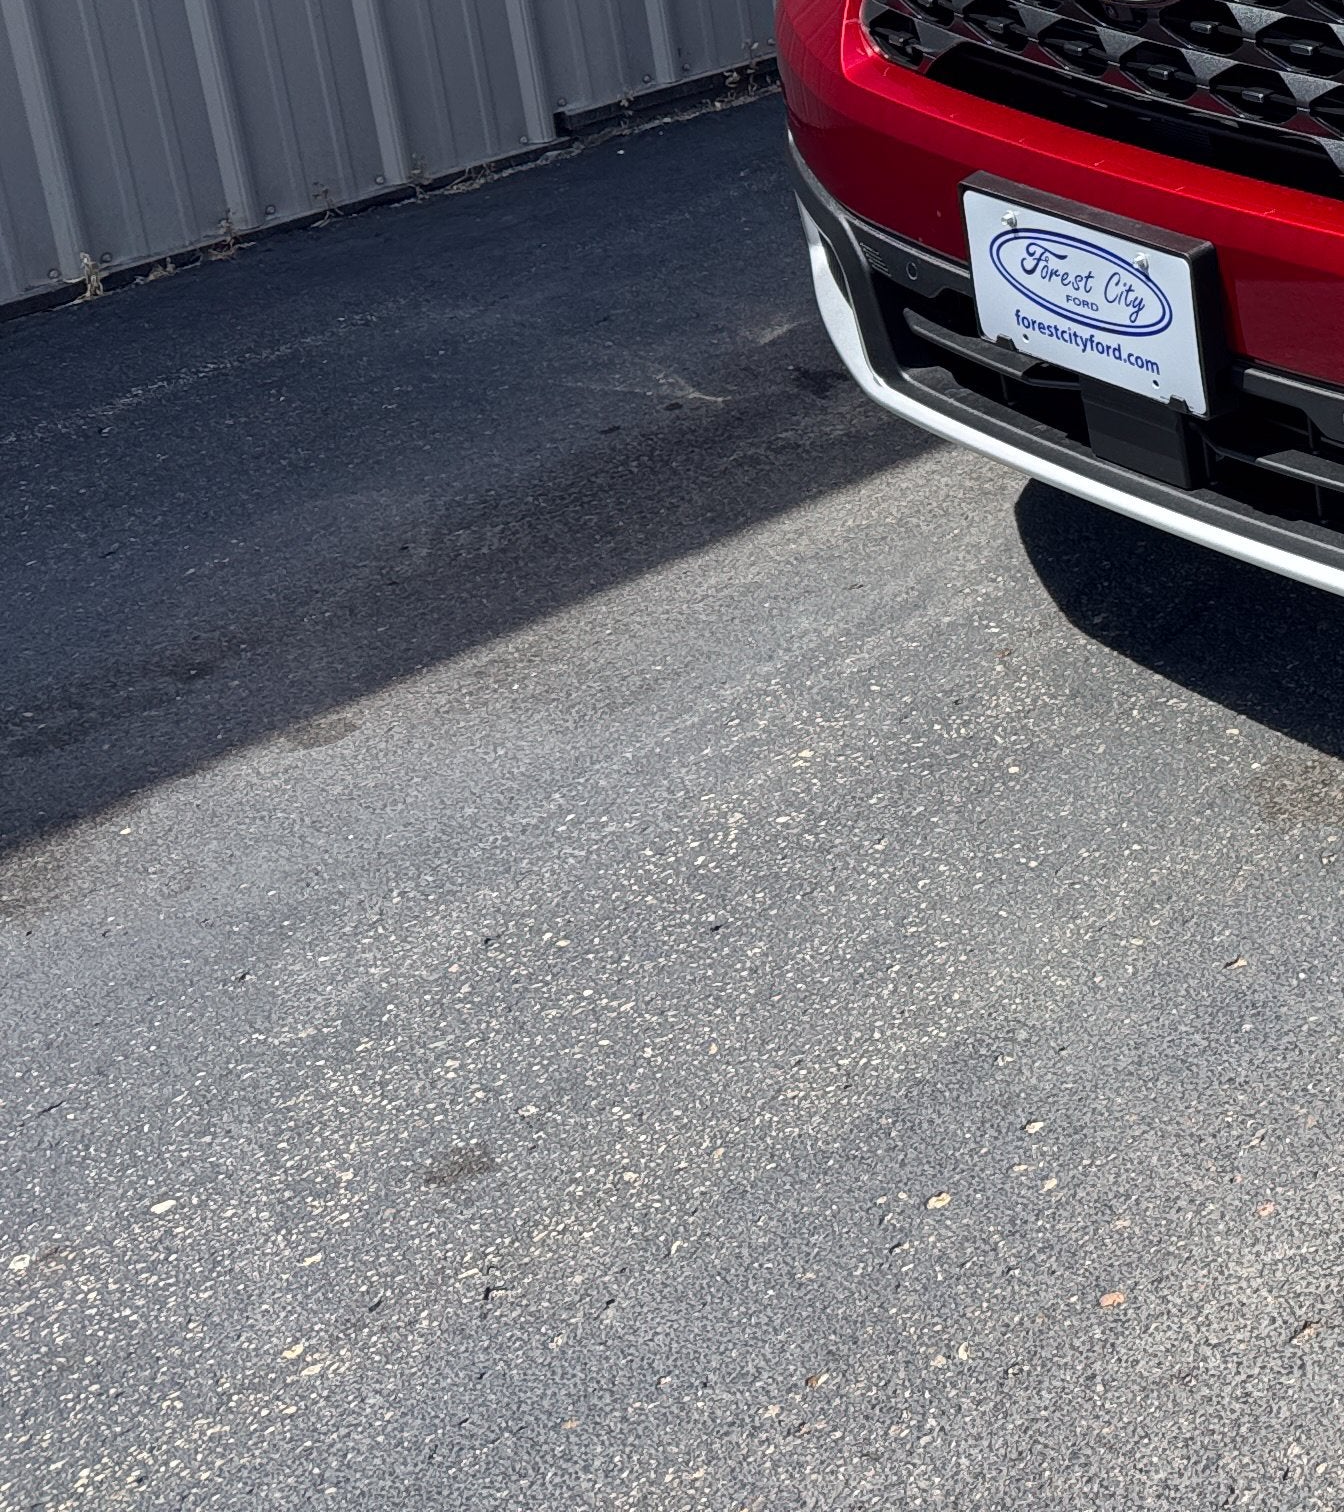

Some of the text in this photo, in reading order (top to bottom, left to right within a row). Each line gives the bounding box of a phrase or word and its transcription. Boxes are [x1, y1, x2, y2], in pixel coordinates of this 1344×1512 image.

[1020, 241, 1146, 323] Forest City
[1065, 294, 1099, 312] FORD
[1014, 308, 1161, 375] forestcityford.com
